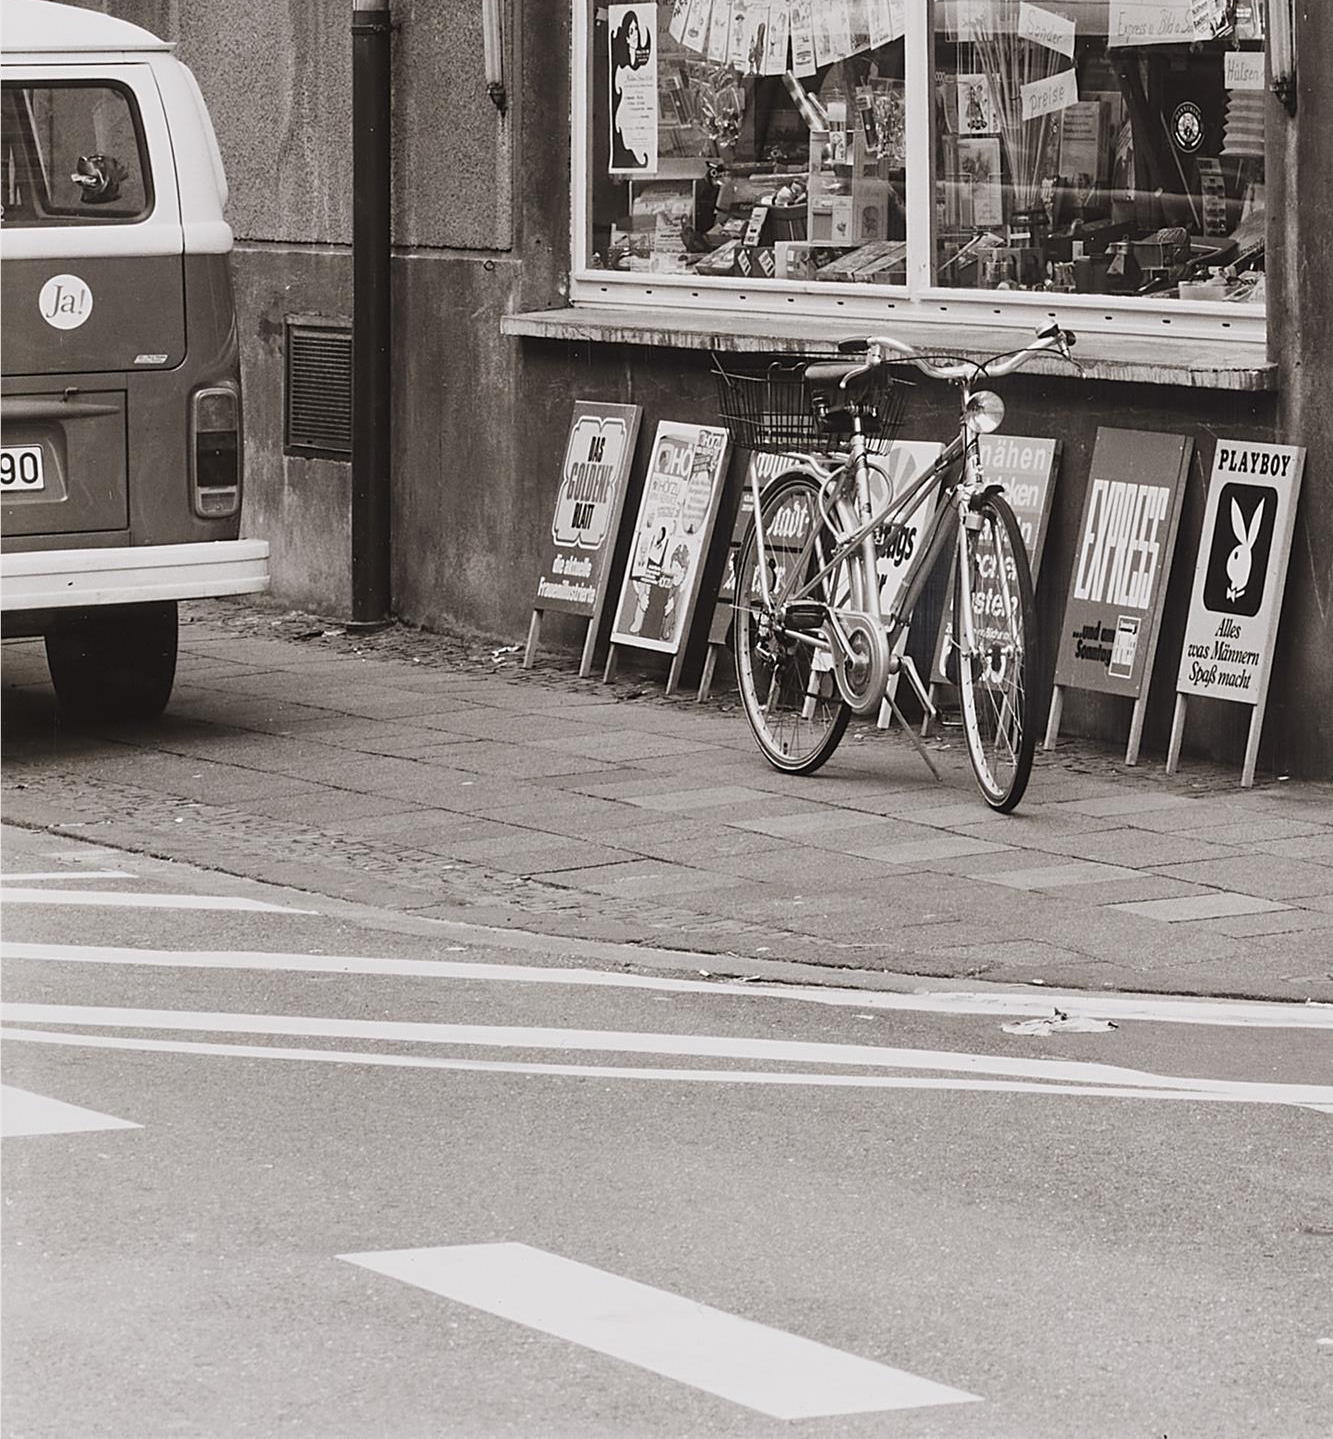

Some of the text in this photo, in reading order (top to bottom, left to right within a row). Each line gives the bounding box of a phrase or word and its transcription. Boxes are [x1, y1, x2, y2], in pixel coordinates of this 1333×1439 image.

[46, 284, 86, 318] Ja!
[588, 436, 606, 462] DAS
[1217, 448, 1291, 477] PLAYBOY
[567, 462, 613, 503] GOLDENE
[572, 502, 595, 529] BLATT
[1074, 478, 1170, 610] EXPRESS
[1215, 618, 1241, 639] Alles
[1188, 641, 1260, 667] was Männern
[1189, 661, 1252, 690] Spaß macht
